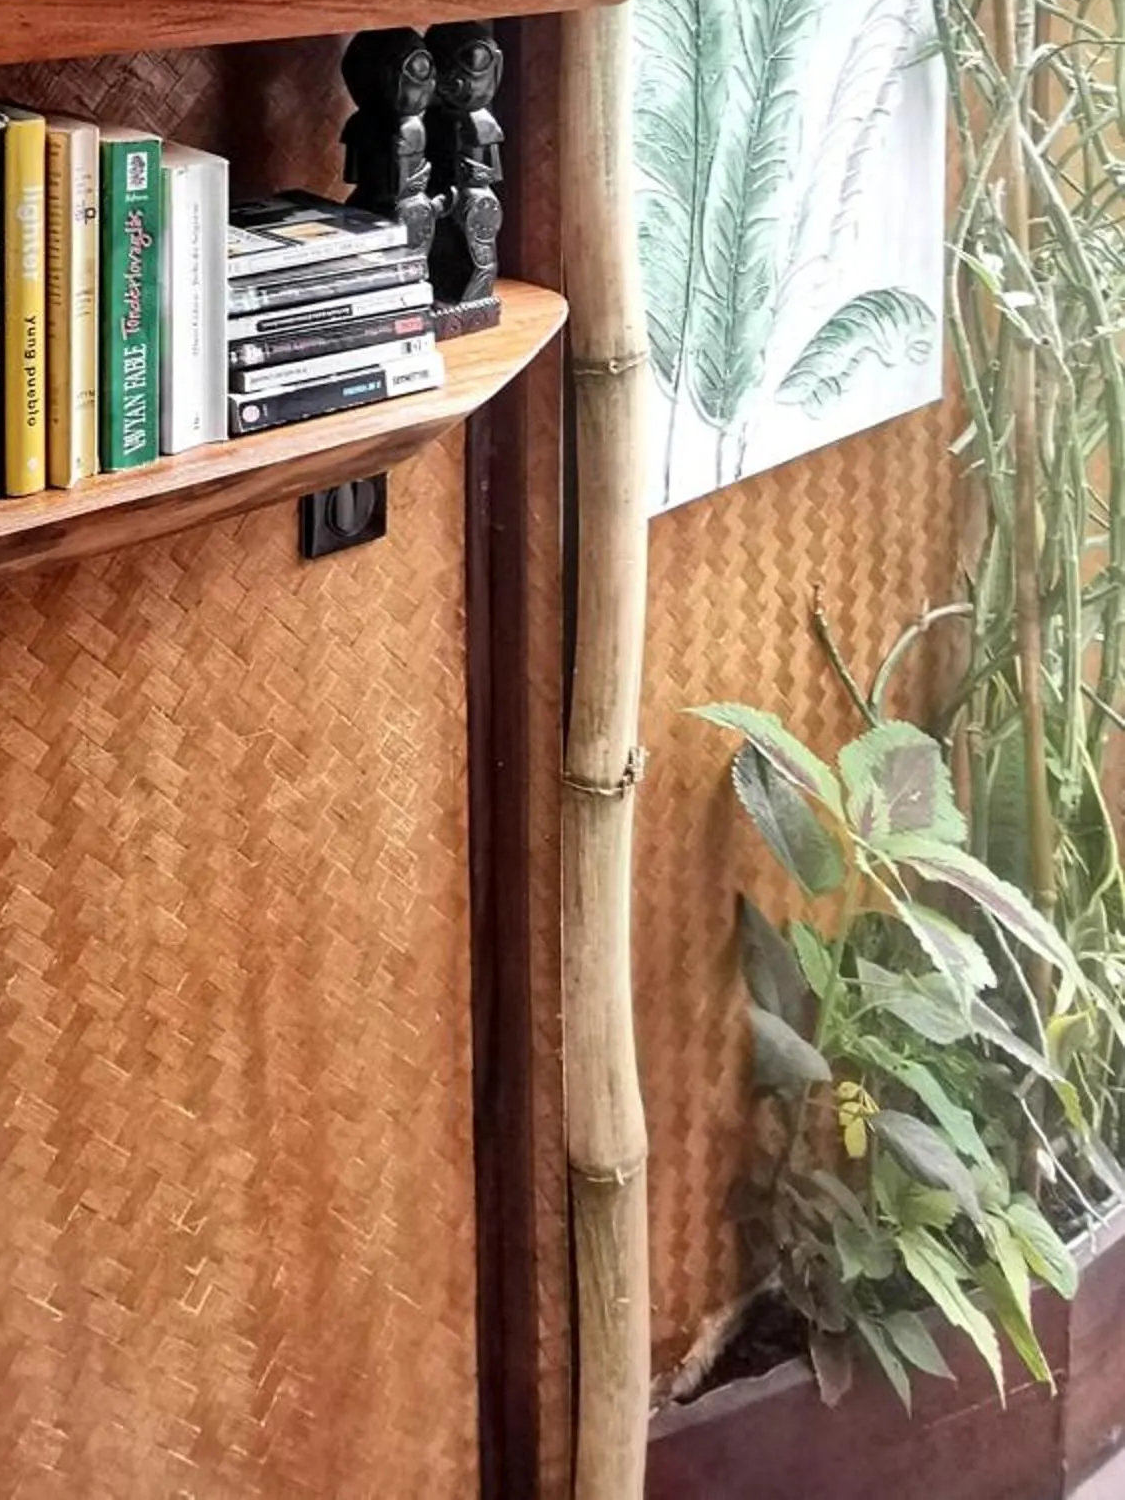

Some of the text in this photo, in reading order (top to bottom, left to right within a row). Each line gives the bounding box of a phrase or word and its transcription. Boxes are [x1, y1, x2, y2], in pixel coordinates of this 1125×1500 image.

[17, 184, 44, 282] lighter
[25, 316, 38, 426] yung pueblo
[122, 343, 146, 391] FABLE
